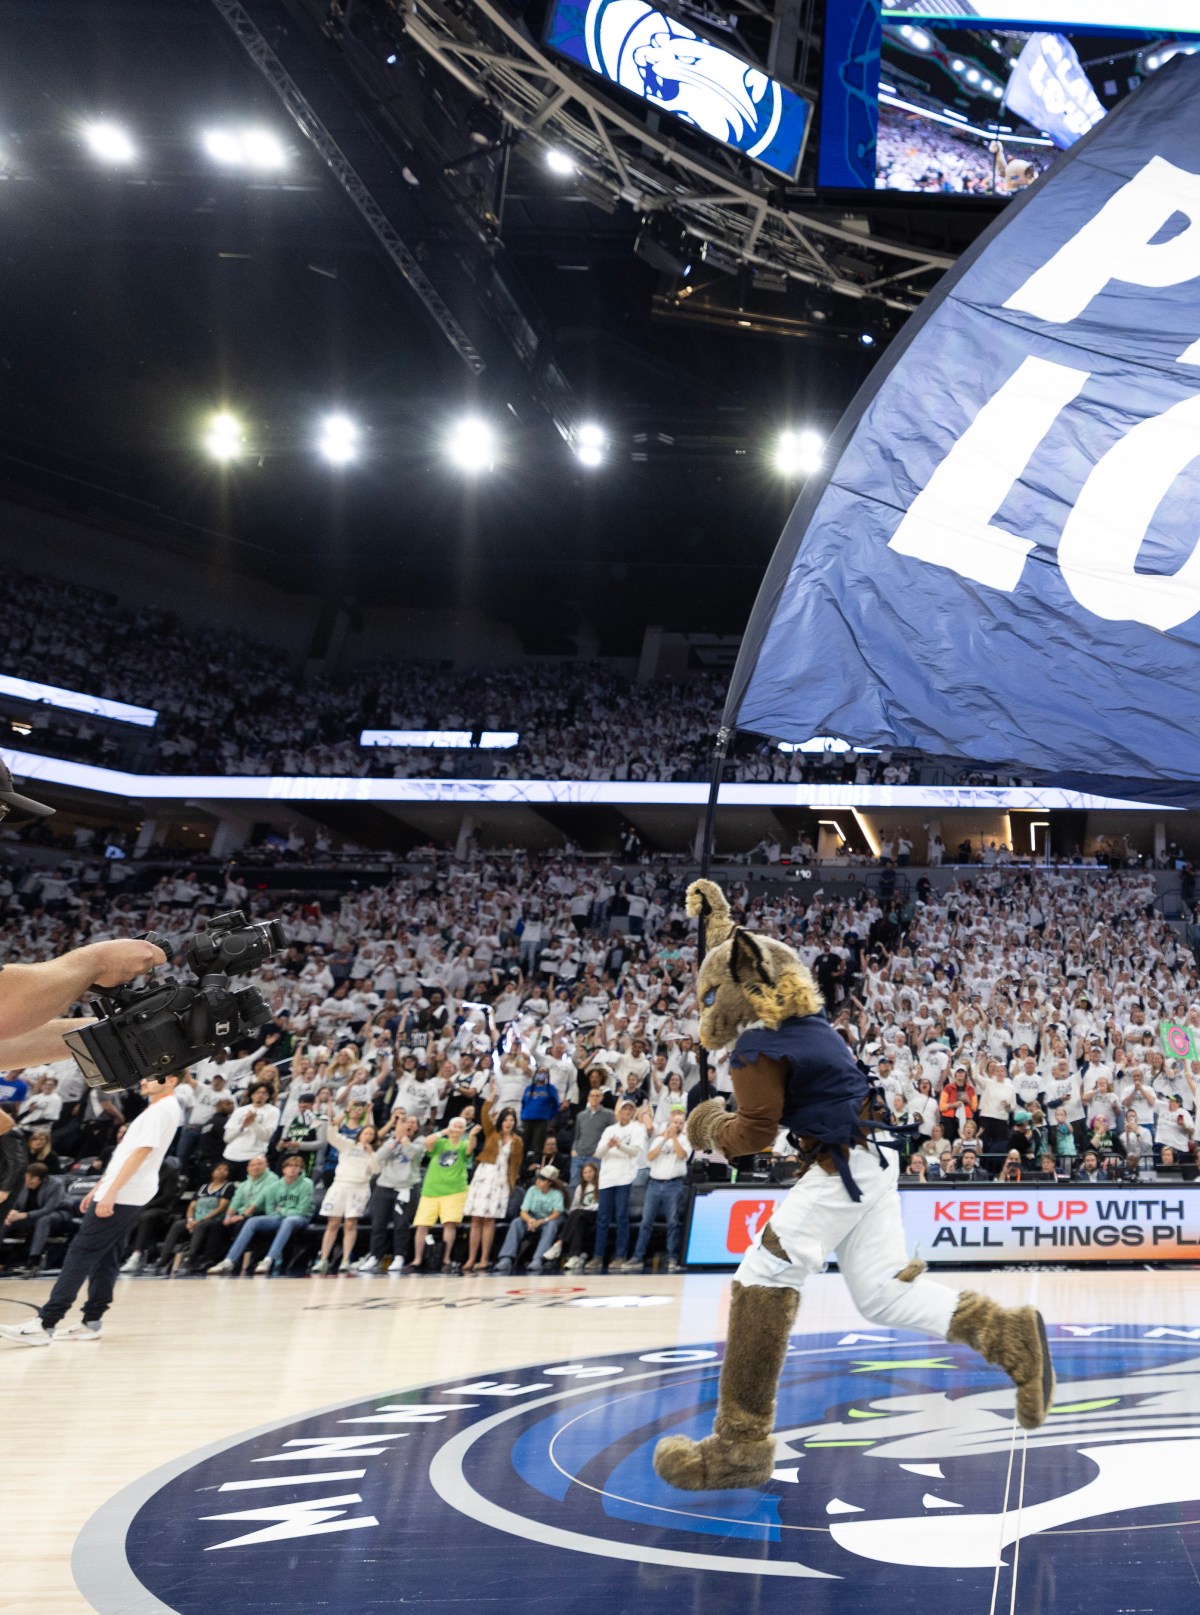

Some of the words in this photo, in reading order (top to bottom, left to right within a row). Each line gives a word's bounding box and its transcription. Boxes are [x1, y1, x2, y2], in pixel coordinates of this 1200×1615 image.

[933, 1201, 1030, 1221] KEEP
[1037, 1201, 1089, 1221] UP
[1096, 1200, 1184, 1220] WITH
[932, 1226, 1004, 1247] ALL
[1012, 1224, 1144, 1246] THINGS
[198, 1332, 898, 1551] MINNESOA
